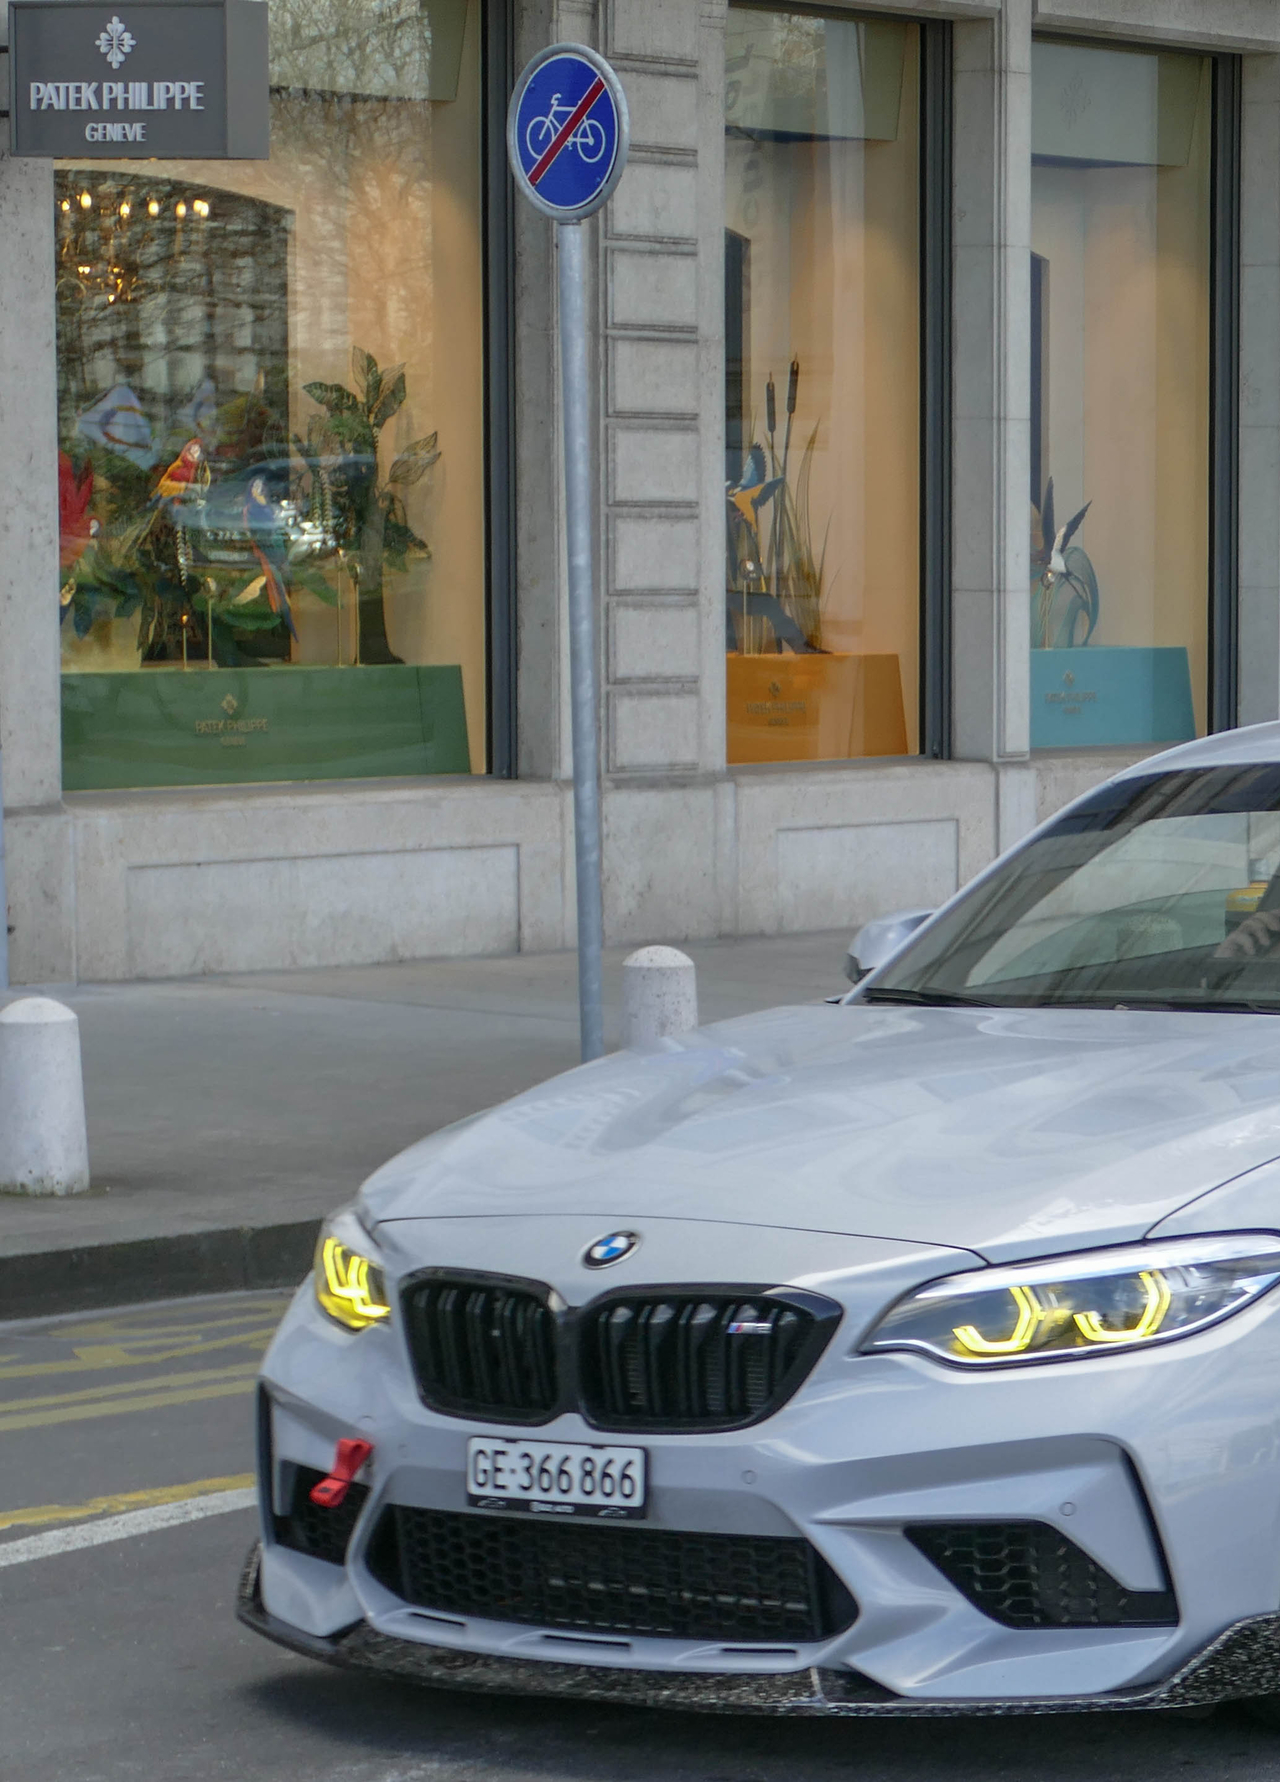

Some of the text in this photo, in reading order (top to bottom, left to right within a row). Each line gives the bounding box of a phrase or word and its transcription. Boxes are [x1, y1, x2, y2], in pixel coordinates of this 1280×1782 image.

[30, 81, 205, 110] PATEK PHILIPPE
[85, 122, 147, 142] GENEVE
[196, 718, 268, 733] PATEK PHILIPPE
